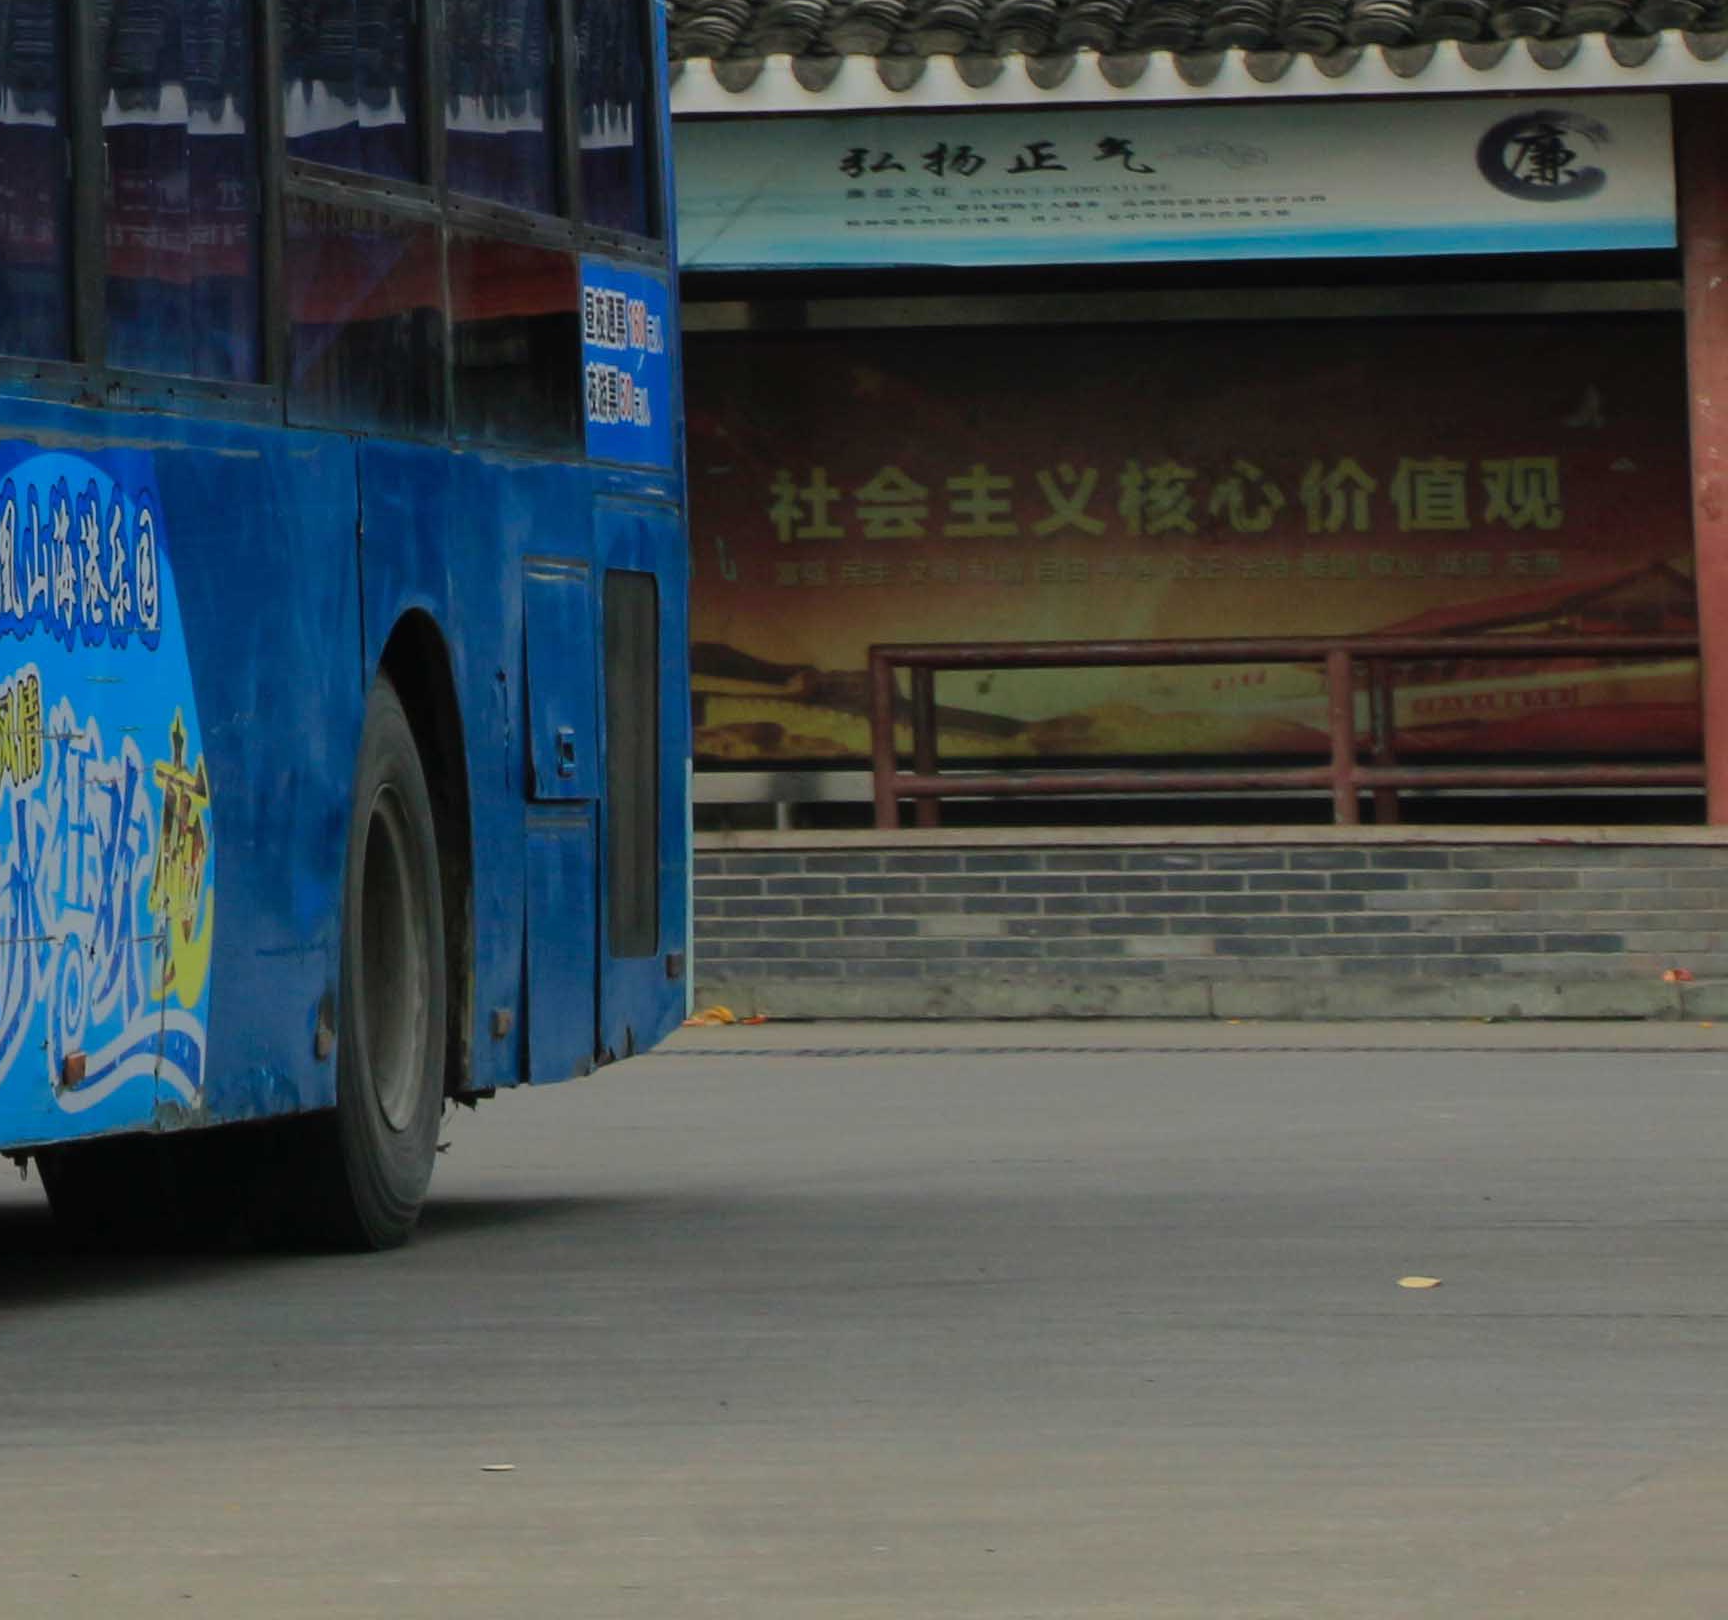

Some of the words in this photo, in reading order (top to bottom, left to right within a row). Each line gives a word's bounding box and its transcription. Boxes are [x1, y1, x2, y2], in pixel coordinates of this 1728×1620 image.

[838, 135, 1157, 178] 弘扬正气
[768, 455, 1565, 544] 社会主义核心价值观
